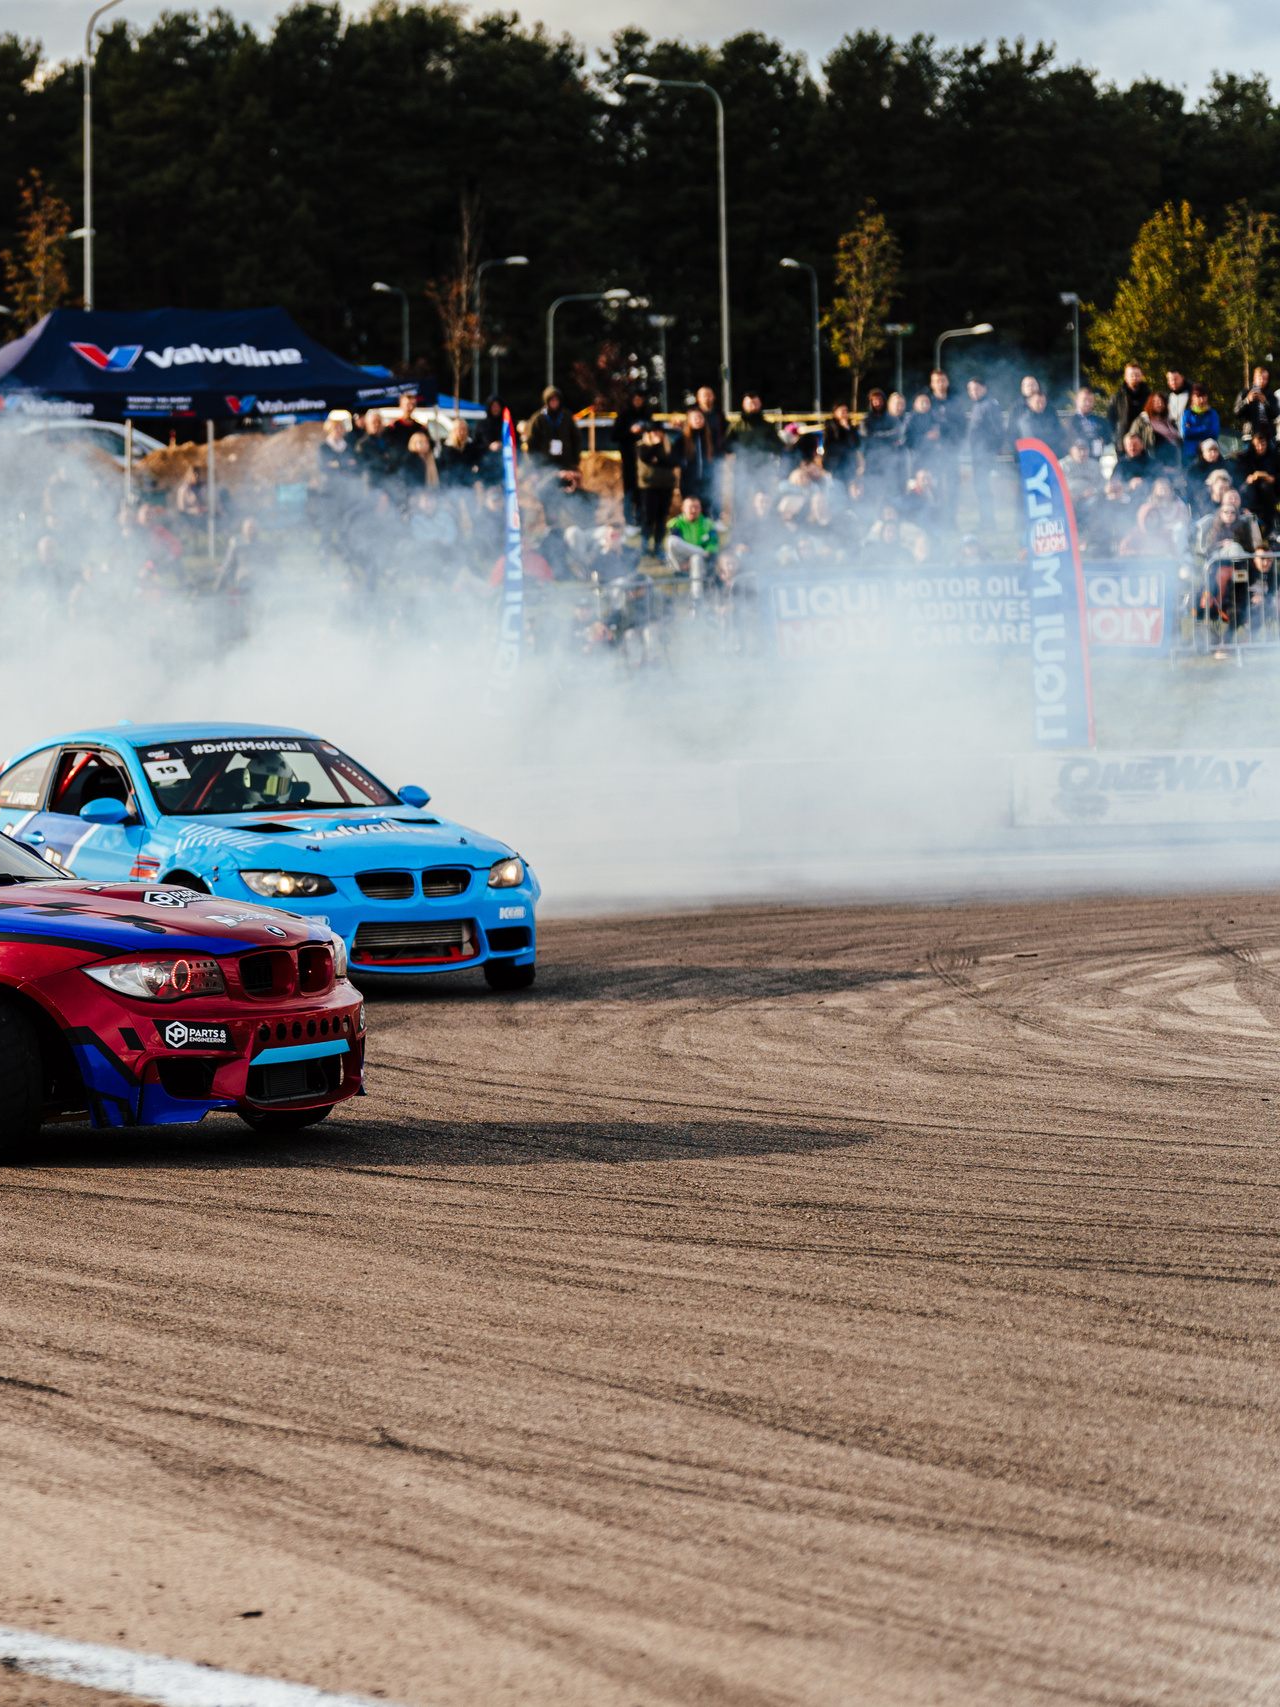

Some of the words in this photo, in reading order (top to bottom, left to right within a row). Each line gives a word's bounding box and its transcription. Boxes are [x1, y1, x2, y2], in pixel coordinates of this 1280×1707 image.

[145, 344, 302, 369] Valvoline
[778, 583, 880, 618] LIQUI
[896, 577, 981, 600] MOTOR
[986, 576, 1028, 598] OIL
[1088, 576, 1159, 606] QUI
[907, 599, 1031, 622] ADDITIVES
[783, 618, 884, 655] MOLY
[912, 624, 962, 646] CAR
[967, 621, 1031, 645] CARE
[1089, 608, 1162, 643] OLY
[156, 765, 179, 775] 19
[189, 1028, 218, 1038] PARTS
[219, 1029, 227, 1038] &
[189, 1036, 227, 1044] ENGINEERING
